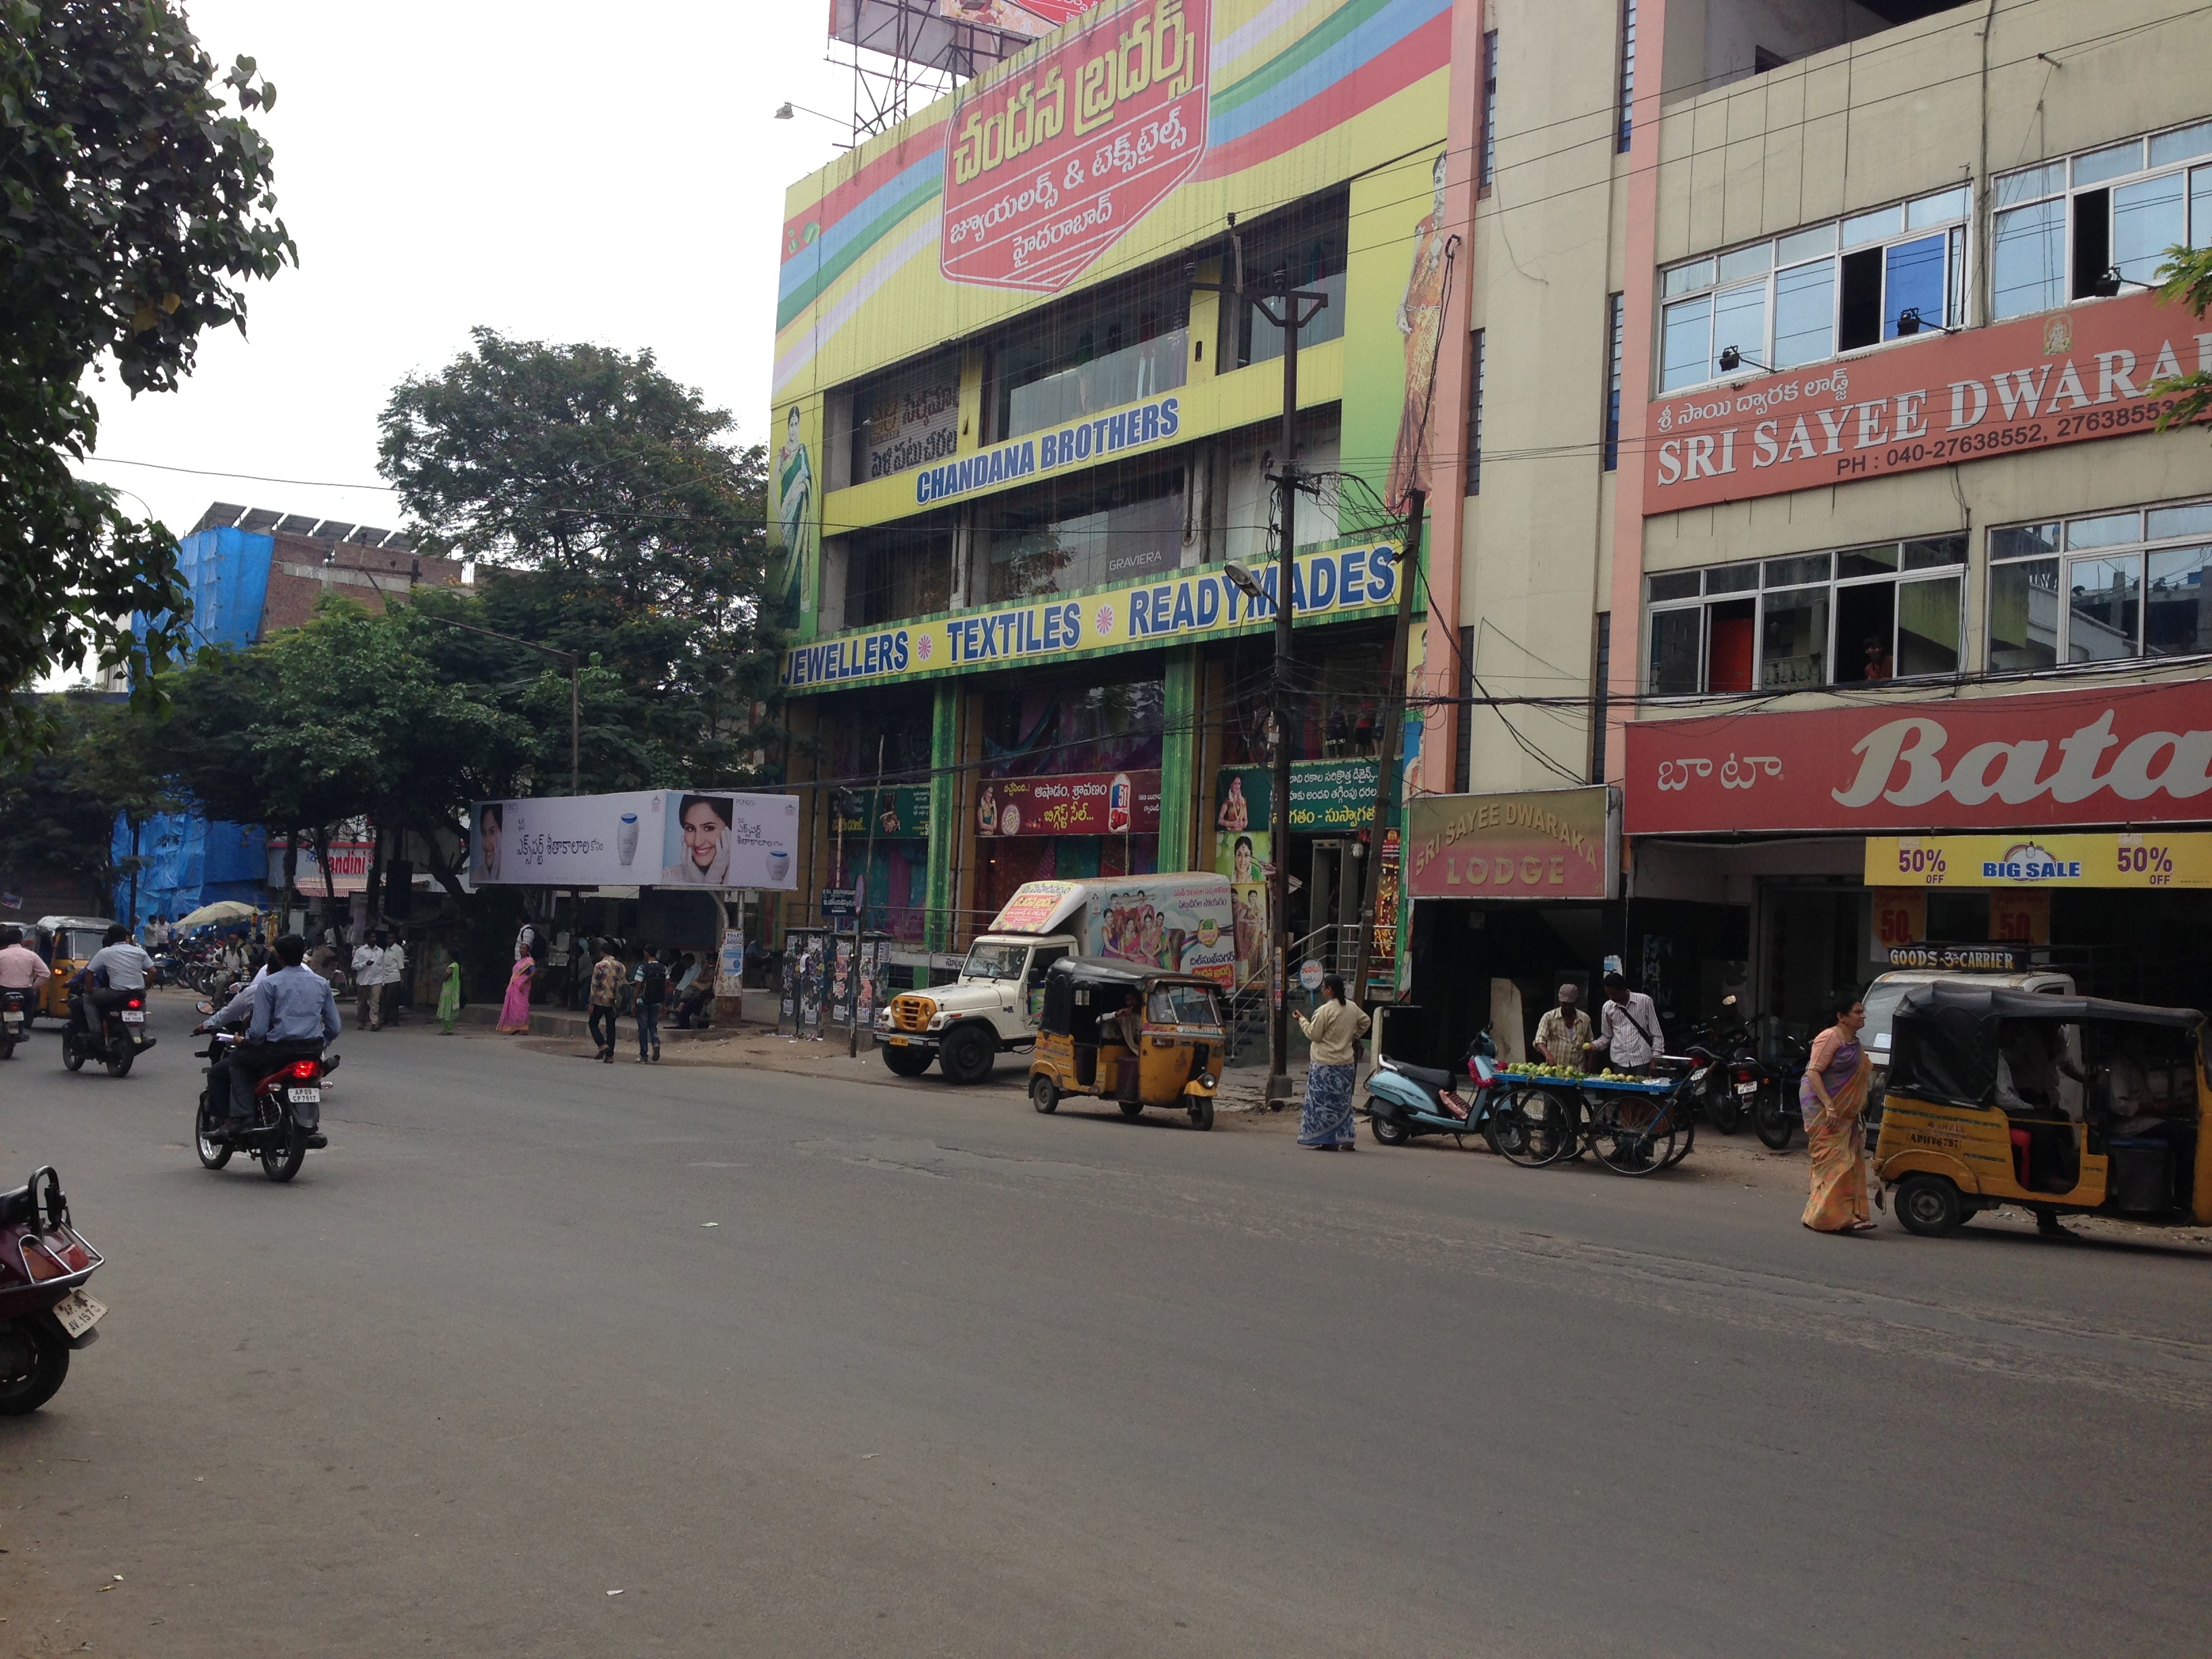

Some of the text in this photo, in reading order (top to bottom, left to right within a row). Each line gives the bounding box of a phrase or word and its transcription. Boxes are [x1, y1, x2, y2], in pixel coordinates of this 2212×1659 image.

[953, 0, 1196, 186] చందన బ్రదర్స్
[1063, 159, 1086, 190] &
[1012, 192, 1113, 268] హైదరాబాద్
[1657, 405, 1673, 433] శ్రీ
[1677, 396, 1732, 425] సాయి
[1736, 379, 1799, 415] ద్వారక
[916, 439, 1036, 506] CHANDANA
[1040, 397, 1180, 472] BROTHERS
[1657, 428, 1739, 487] SRI
[1752, 388, 1929, 469] SAYEE
[1837, 455, 1867, 476] PH
[1886, 422, 2049, 467] 040-27638552,
[1109, 550, 1162, 571] GRAVIERA
[783, 545, 1398, 689] JEWELLERS TEXTILES READYMADES
[1830, 708, 2212, 808] Bata
[1325, 805, 1376, 827] సుస్వాగత
[1416, 802, 1598, 876] SRI SAYEE DWARAKA
[319, 850, 367, 875] andini
[1446, 855, 1565, 885] LODGE
[1898, 848, 1946, 874] 50%
[1982, 861, 2081, 878] BIG SALE
[2117, 846, 2173, 873] 50%
[1926, 873, 1944, 884] OFF
[2150, 874, 2171, 886] OFF
[1889, 949, 1938, 968] GOODS
[1959, 951, 2014, 970] CARRIER
